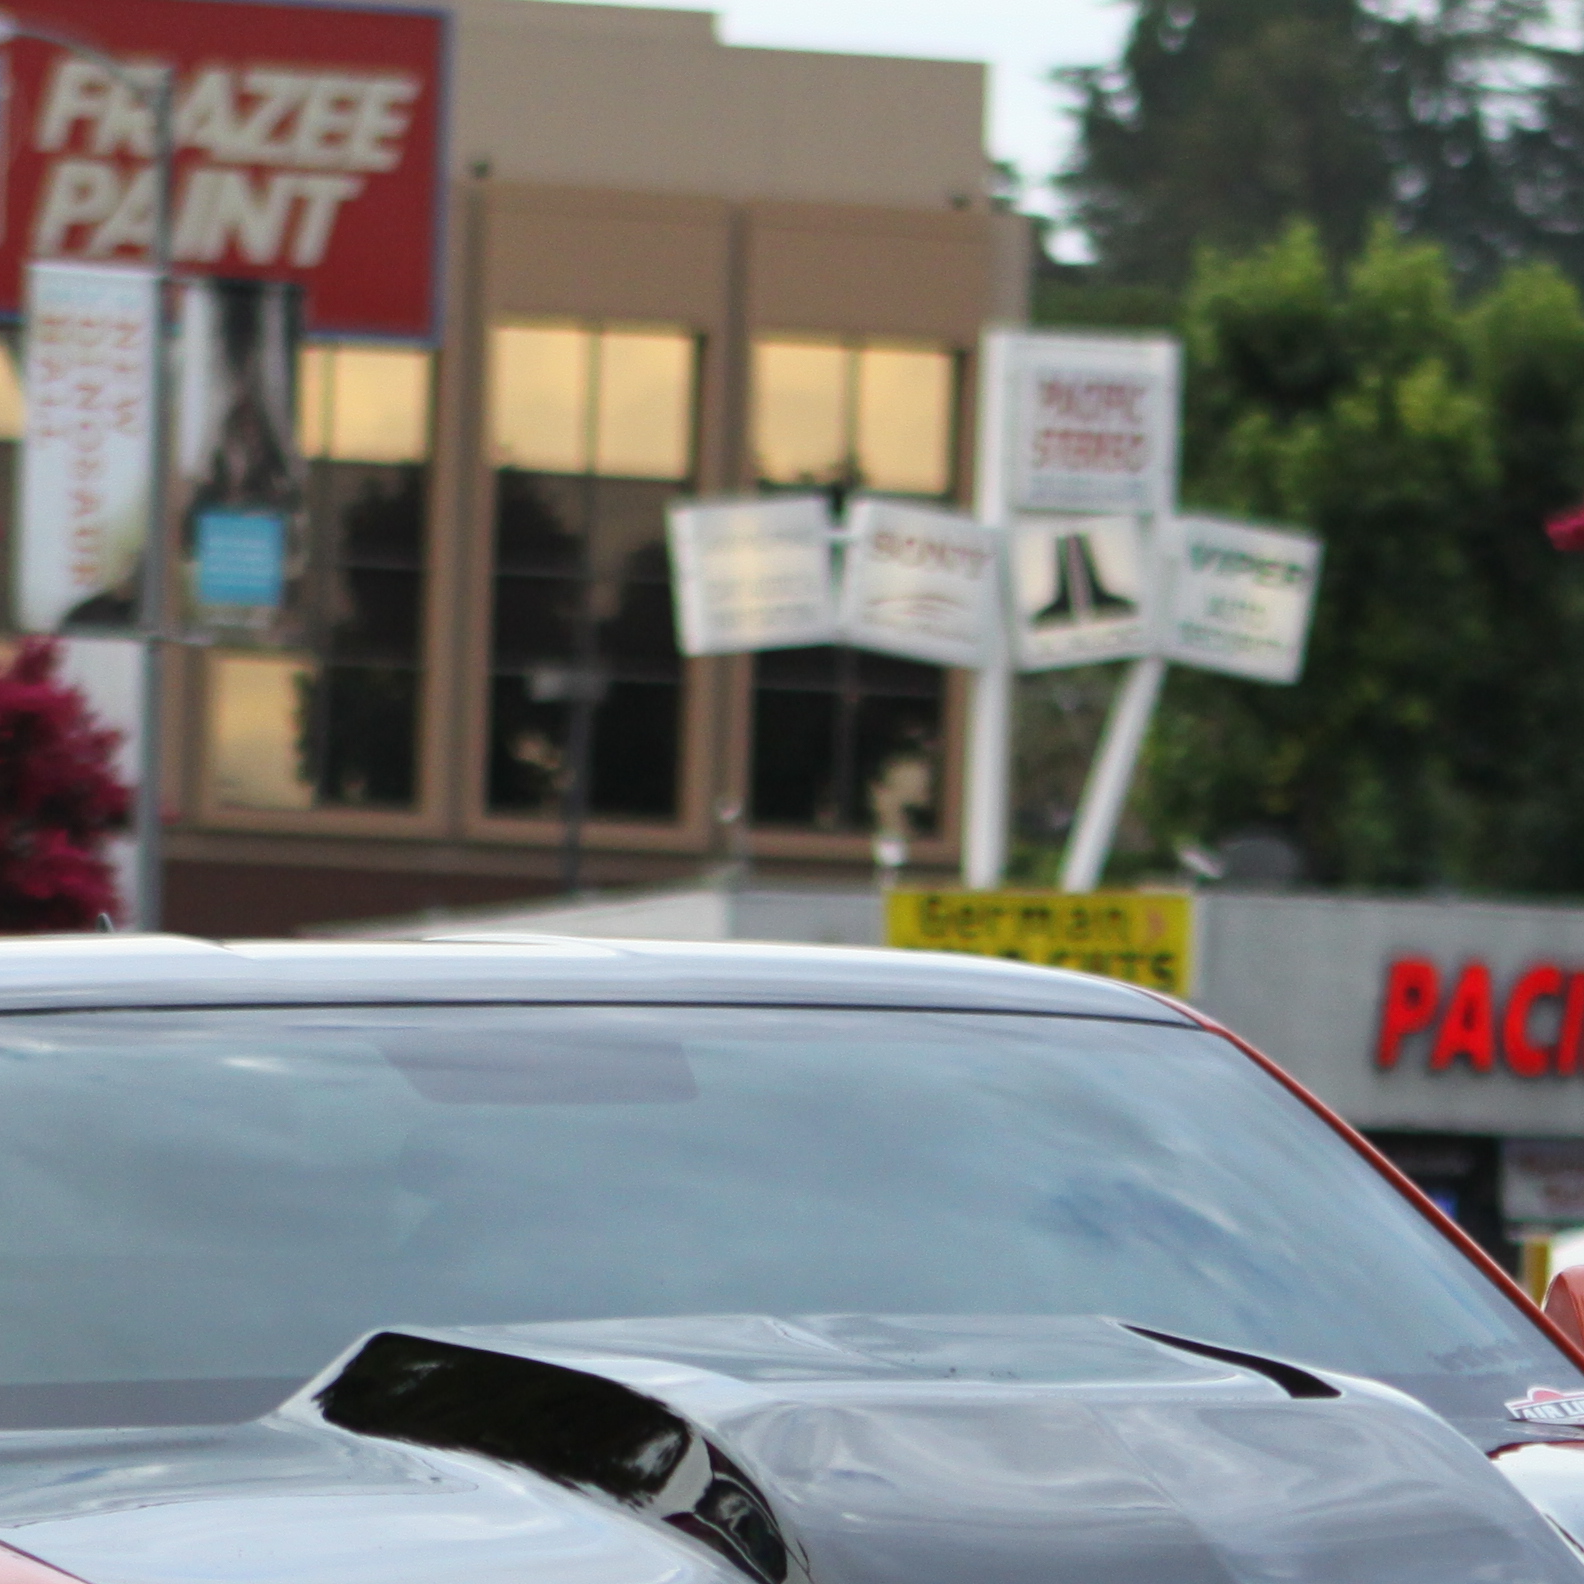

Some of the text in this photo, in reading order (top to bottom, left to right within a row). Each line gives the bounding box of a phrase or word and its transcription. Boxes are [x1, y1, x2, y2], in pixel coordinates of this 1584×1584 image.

[36, 56, 416, 170] FRAZEE
[34, 160, 363, 266] PAINT
[916, 894, 1132, 942] German
[1524, 1402, 1561, 1421] AIR
